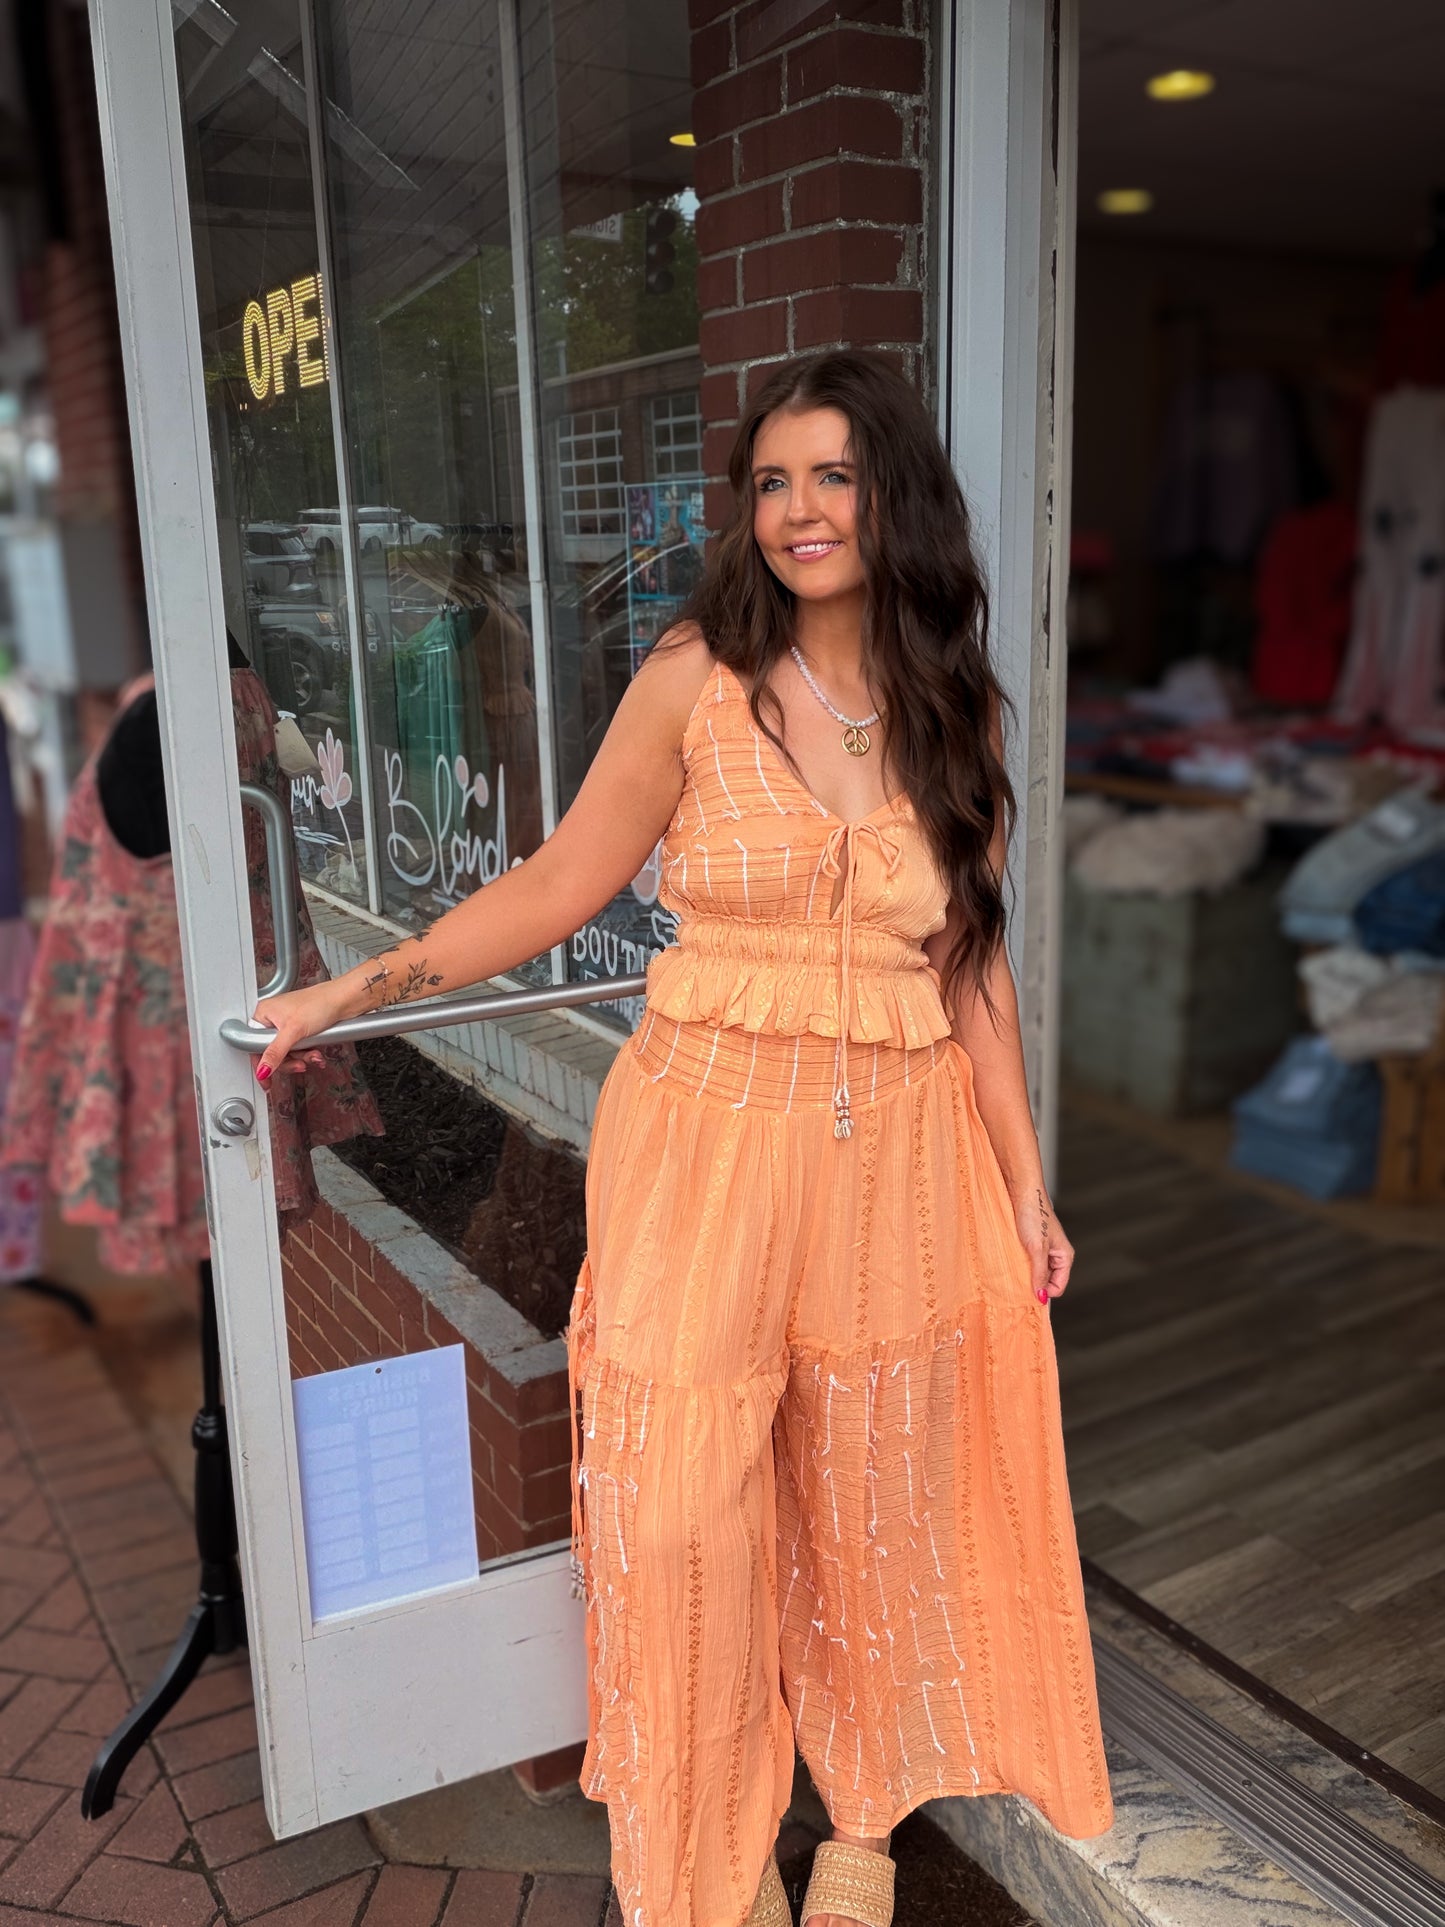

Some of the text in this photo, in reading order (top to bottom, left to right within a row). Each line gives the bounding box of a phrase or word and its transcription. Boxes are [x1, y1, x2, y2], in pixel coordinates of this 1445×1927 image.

[243, 273, 330, 400] OPE
[384, 748, 525, 897] Blond
[572, 926, 661, 977] BOUTI
